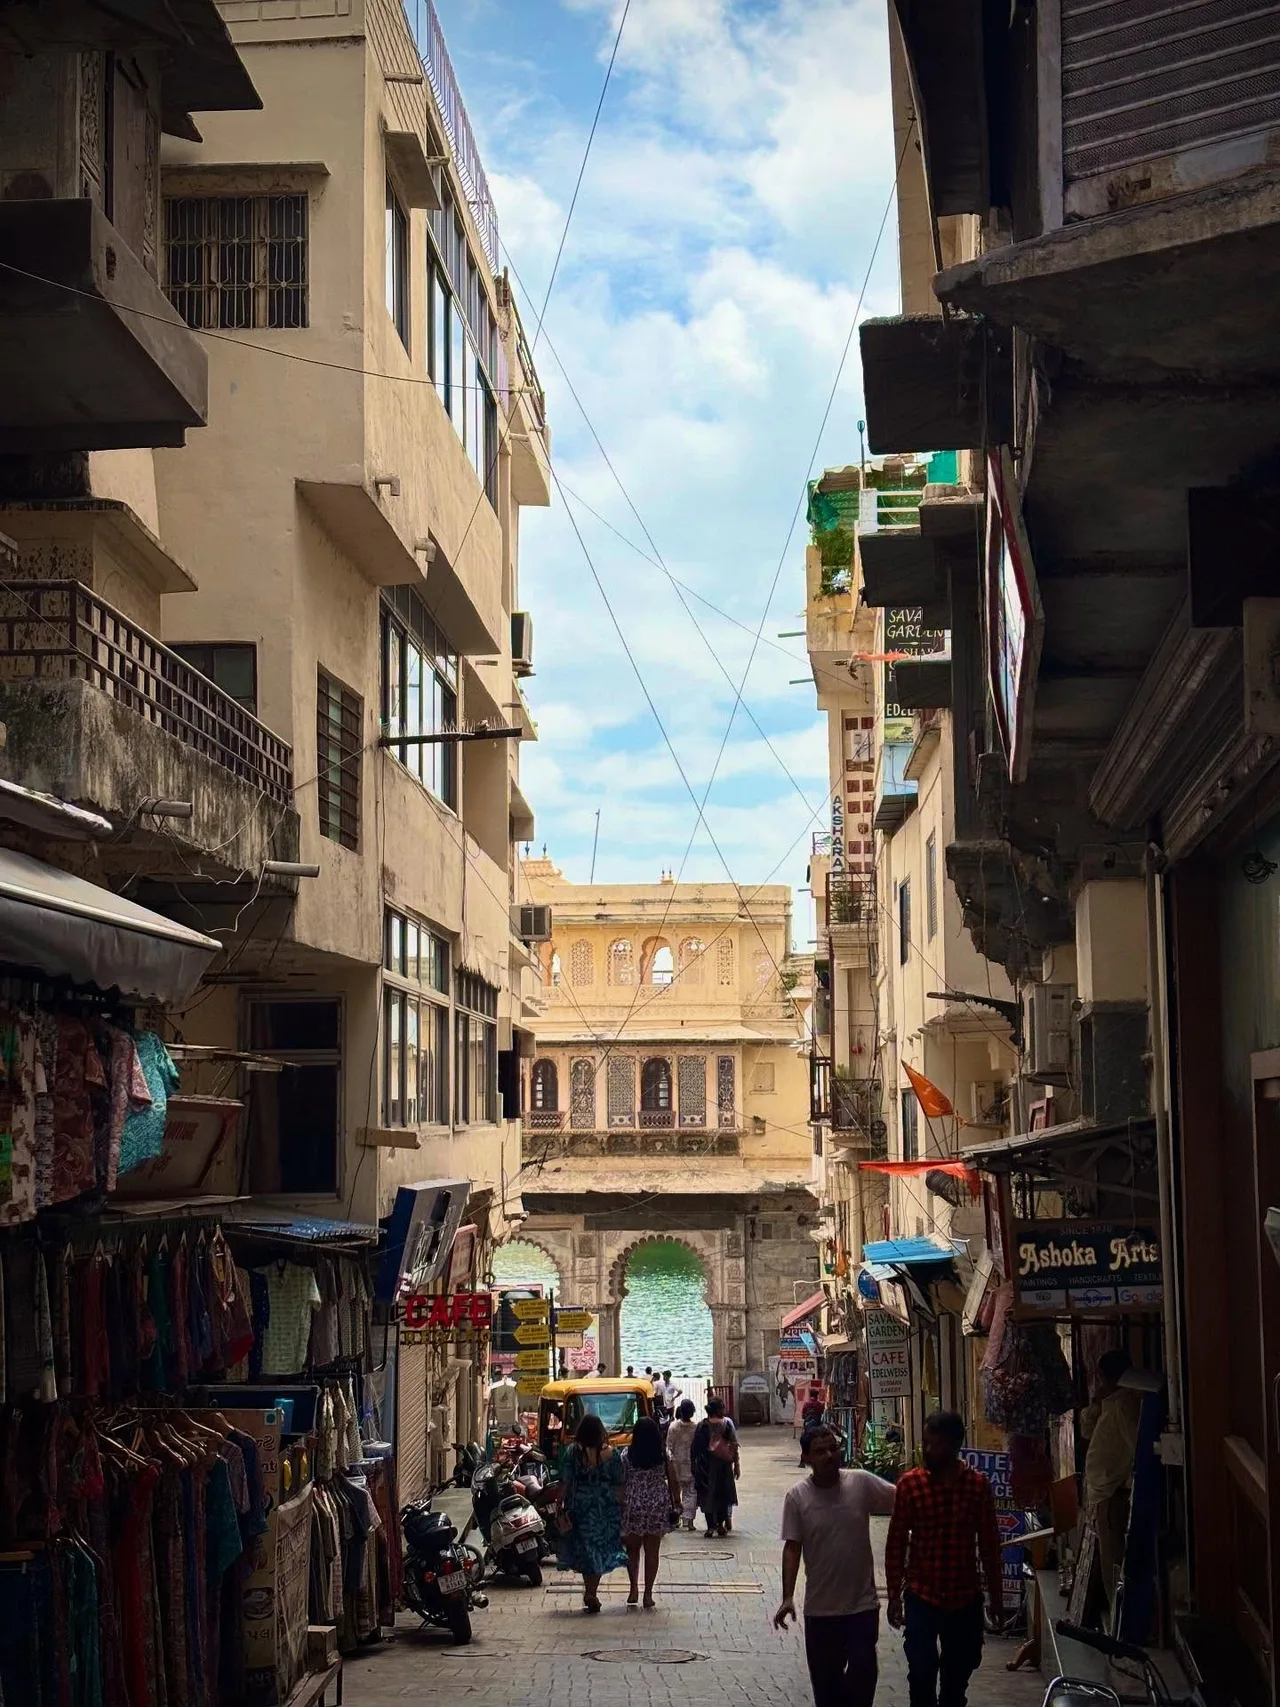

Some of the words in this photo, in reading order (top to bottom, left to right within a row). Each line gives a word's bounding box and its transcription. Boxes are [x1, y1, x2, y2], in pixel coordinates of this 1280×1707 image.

[888, 608, 923, 624] SAVA
[1018, 1239, 1098, 1276] Ashoka
[1108, 1236, 1160, 1271] Arts
[1068, 1273, 1123, 1286] HANDICRAFTS
[404, 1293, 492, 1329] CAFE
[868, 1325, 905, 1338] GARDEN
[872, 1351, 906, 1366] CAFE
[872, 1367, 909, 1379] EDELWEISS
